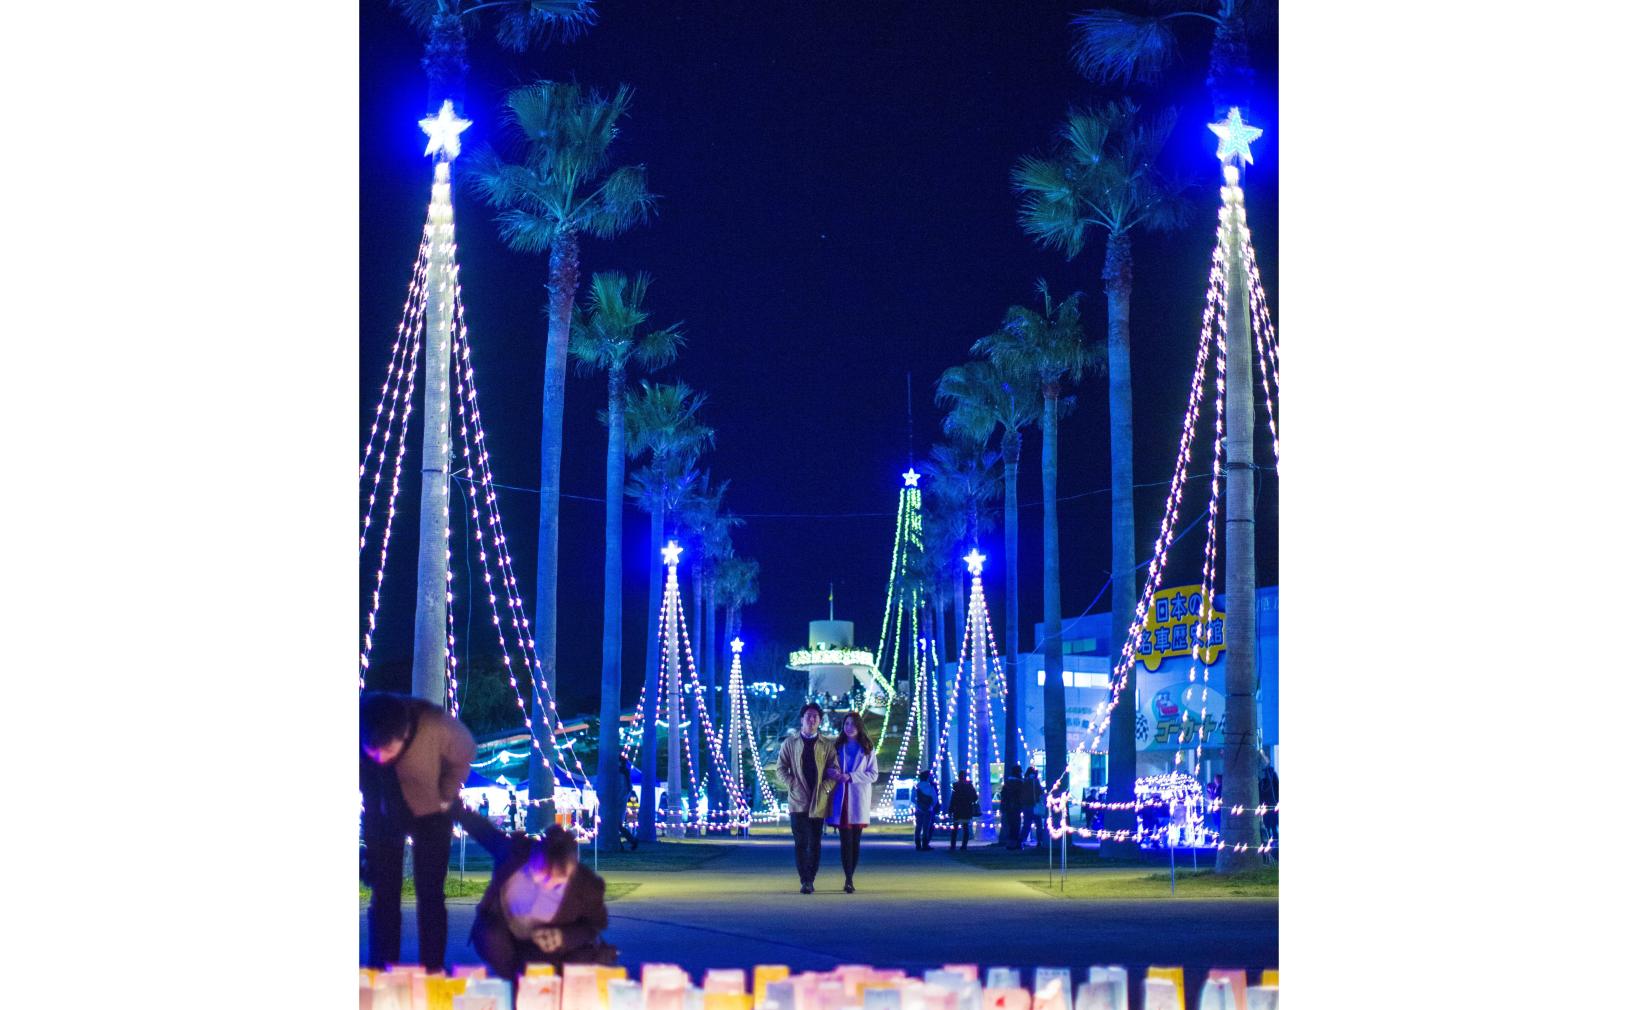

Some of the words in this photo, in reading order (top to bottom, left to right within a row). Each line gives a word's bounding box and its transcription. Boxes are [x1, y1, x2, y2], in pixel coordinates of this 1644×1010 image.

[1156, 591, 1203, 623] 日本の
[1138, 617, 1224, 655] 名車歴史館
[1155, 714, 1217, 743] ゴーカート
